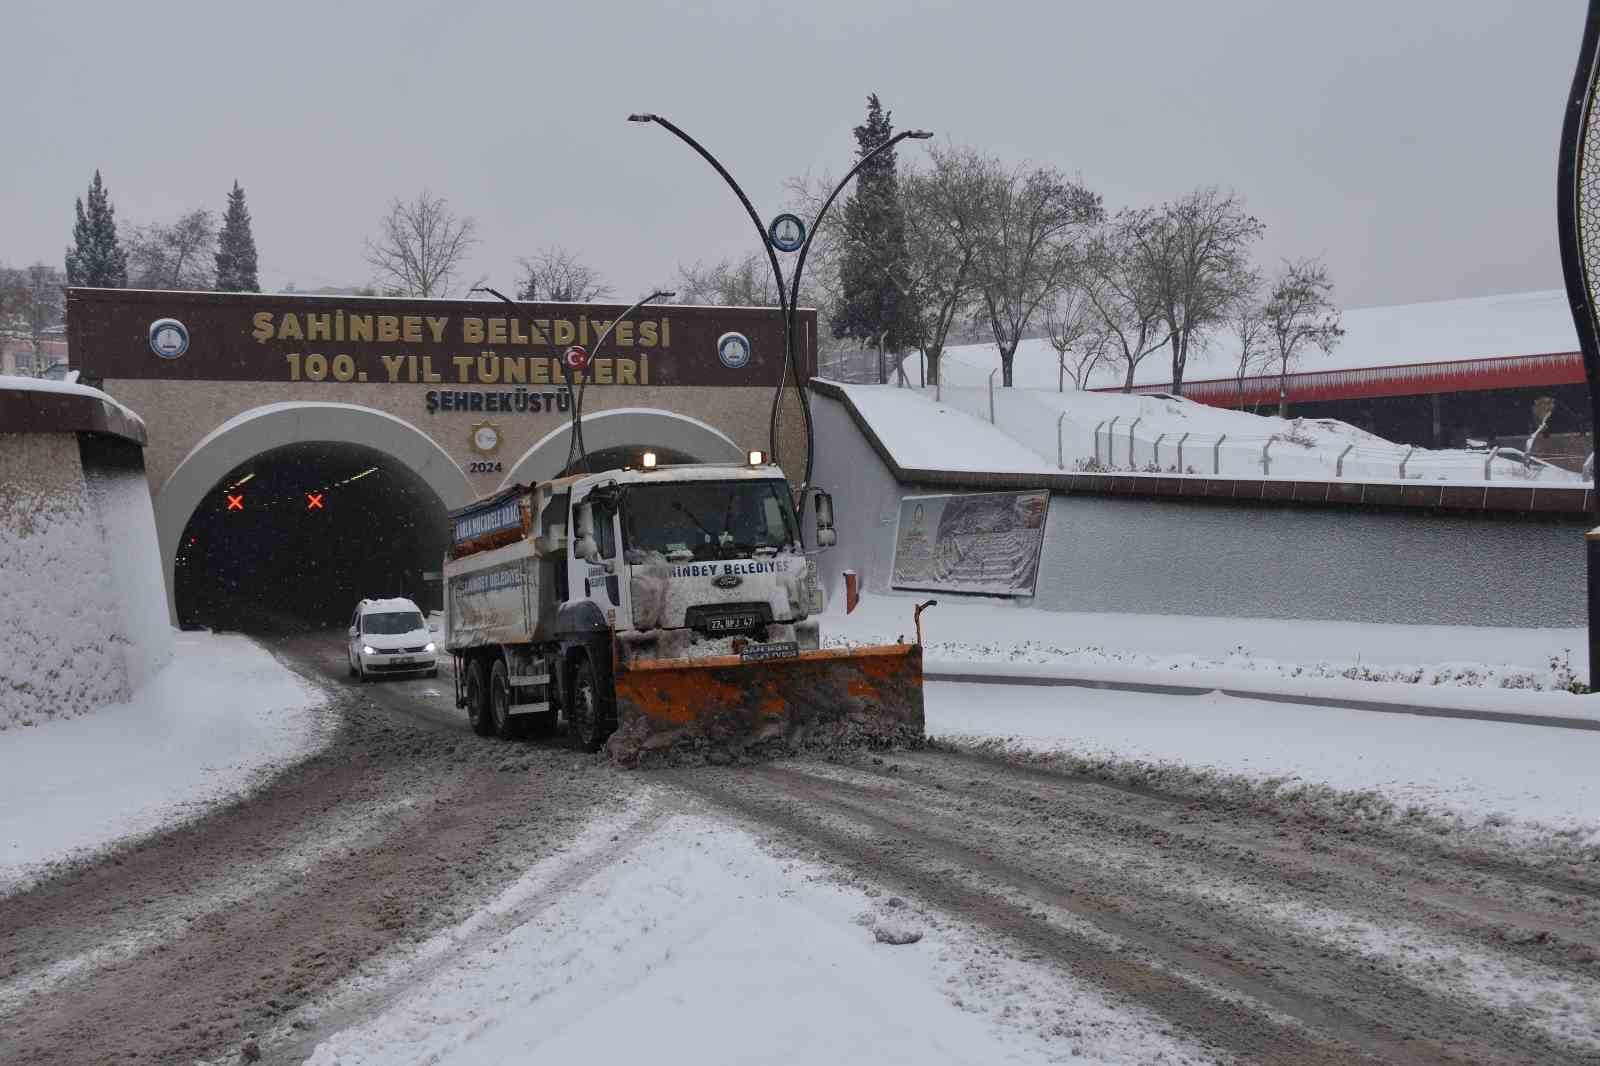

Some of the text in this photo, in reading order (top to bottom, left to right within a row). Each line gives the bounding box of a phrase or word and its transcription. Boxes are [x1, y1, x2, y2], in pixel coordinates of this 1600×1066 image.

[253, 310, 671, 347] ŞAHİNBEY BELEDİYESİ
[286, 352, 649, 385] 100. YIL TÜNELLERİ
[426, 388, 570, 414] ŞEHREKÜSTÜ
[470, 462, 502, 473] 2024
